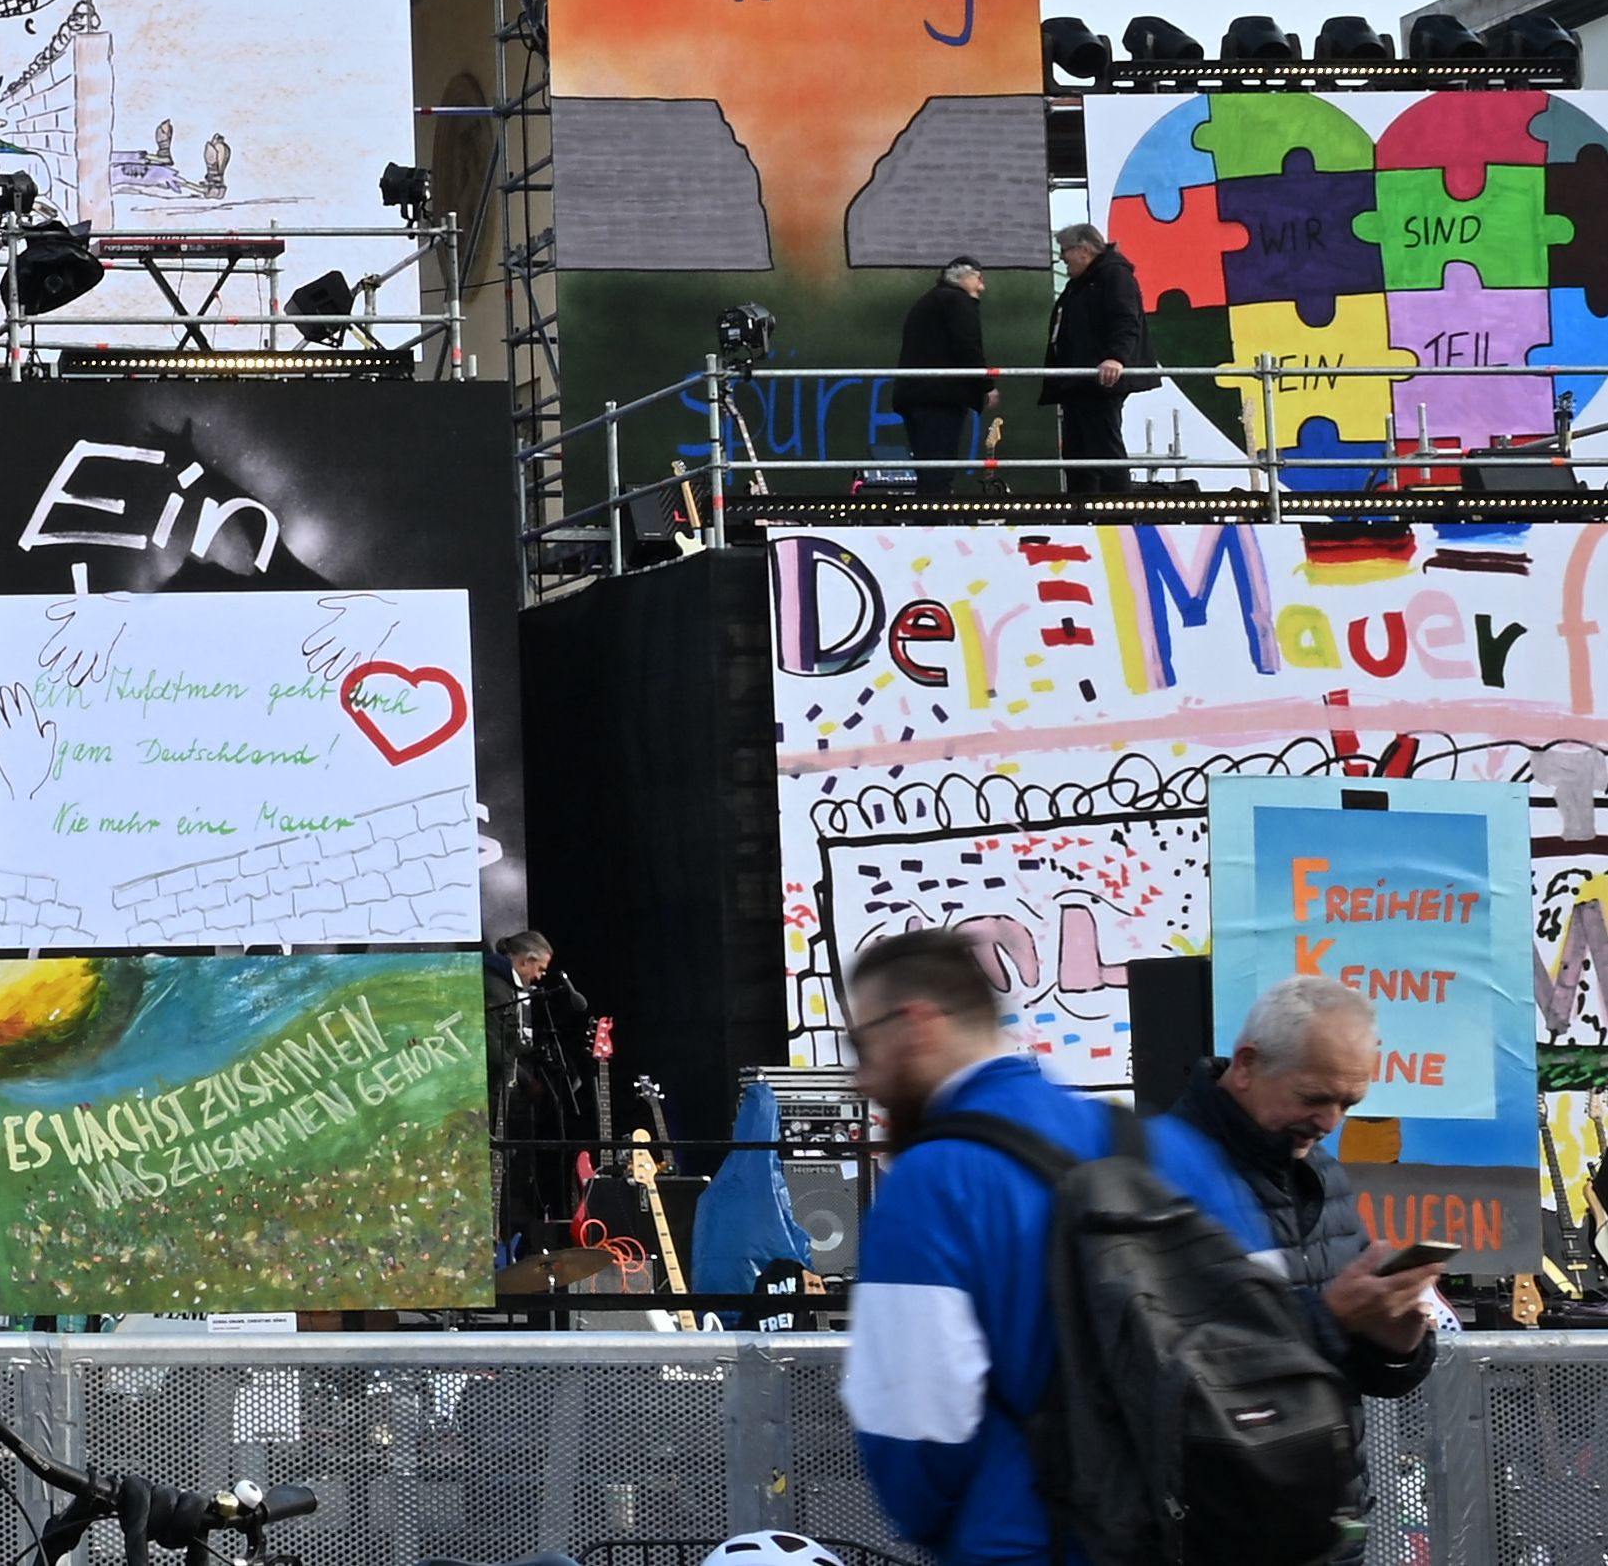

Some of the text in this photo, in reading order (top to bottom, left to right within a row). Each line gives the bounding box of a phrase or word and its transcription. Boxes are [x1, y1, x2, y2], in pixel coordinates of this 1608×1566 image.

[1260, 218, 1326, 258] WIR
[1403, 215, 1482, 249] SIND
[1424, 331, 1510, 370] TEIL
[1278, 354, 1344, 393] EIN
[18, 439, 281, 573] Ein
[345, 681, 423, 715] durch
[53, 801, 91, 834] Nie
[98, 811, 162, 834] mehr
[176, 807, 238, 835] eine
[2, 1110, 53, 1172] ES
[194, 993, 390, 1131] ZUSAMMEN
